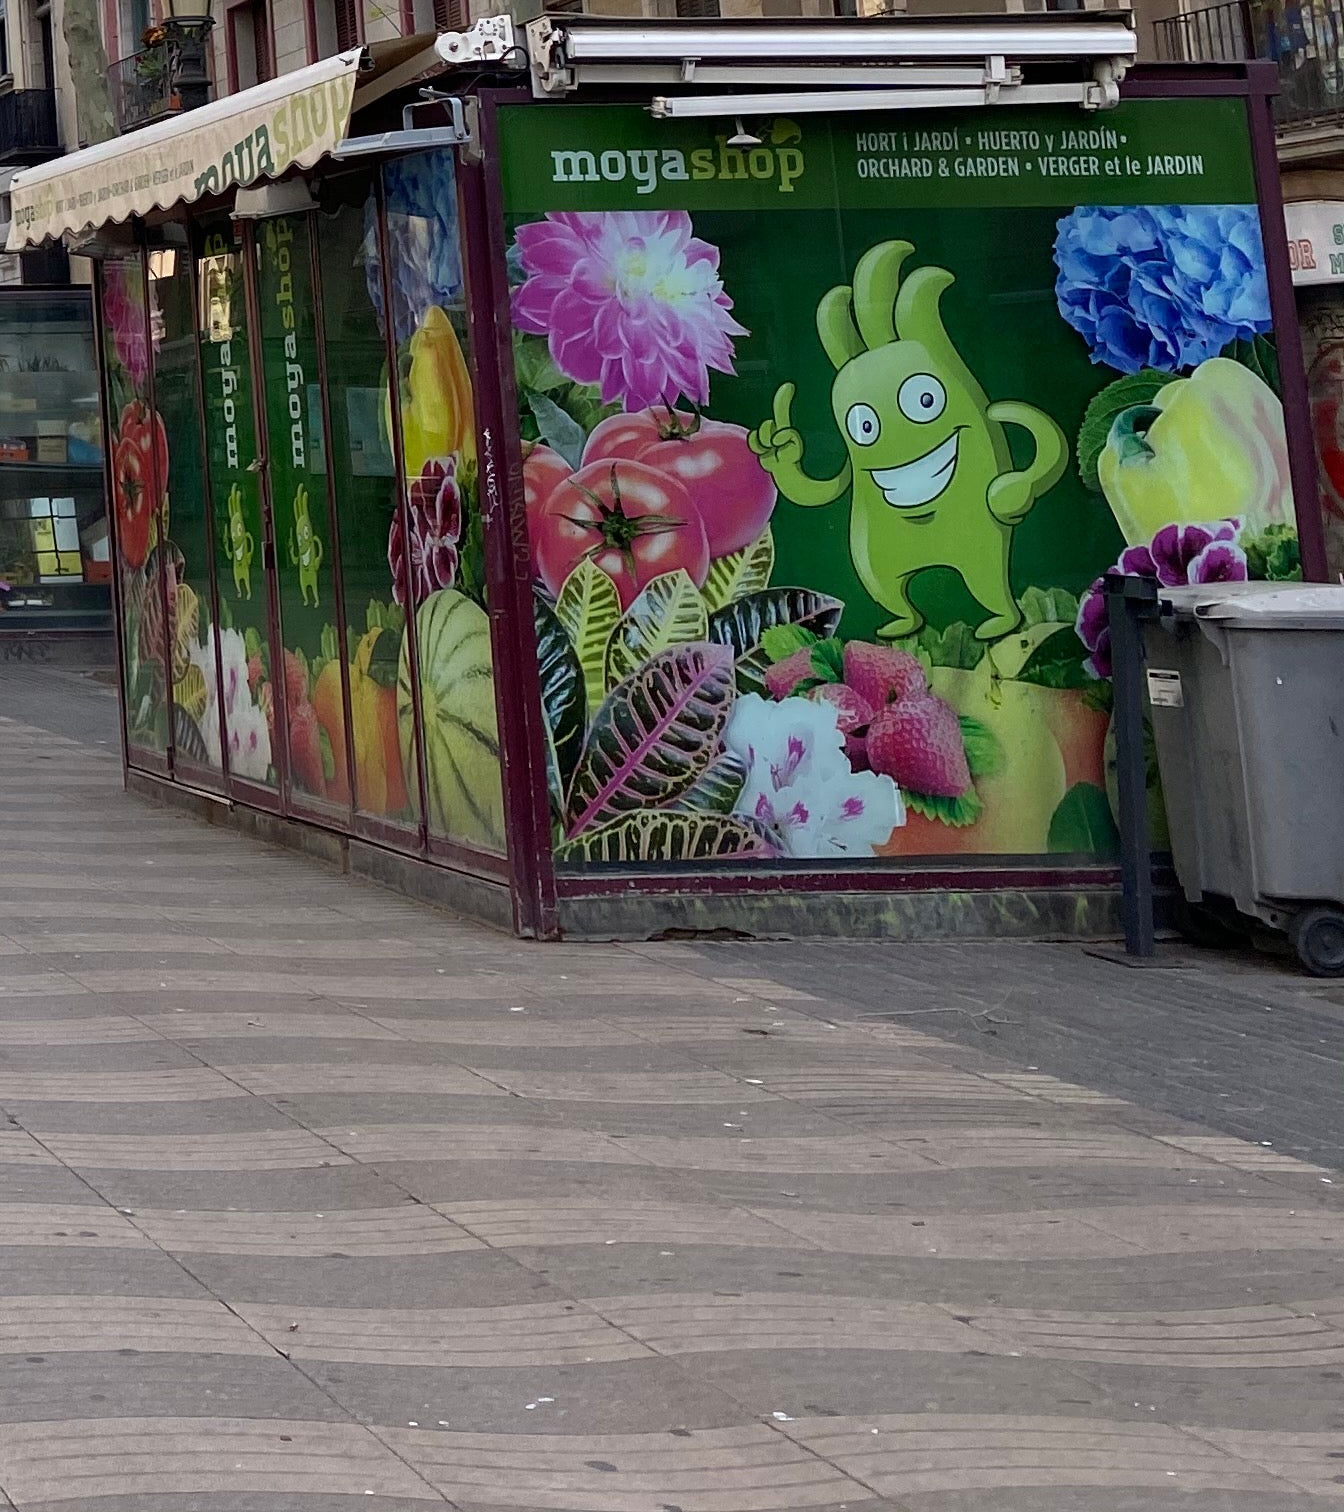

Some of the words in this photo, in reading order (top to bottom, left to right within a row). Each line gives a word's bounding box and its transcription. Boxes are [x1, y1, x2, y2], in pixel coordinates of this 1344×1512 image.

[856, 132, 898, 152] HORT
[914, 127, 959, 152] JARDÍ
[978, 130, 1040, 151] HUERTO
[1044, 133, 1055, 153] y
[550, 134, 805, 194] moyashop
[857, 157, 933, 178] ORCHARD
[938, 157, 950, 178] &
[955, 156, 1020, 177] GARDEN
[1039, 156, 1100, 177] VERGER
[1105, 156, 1121, 176] et
[1126, 156, 1141, 176] le
[1146, 155, 1205, 176] JARDIN
[276, 218, 305, 469] moyashop
